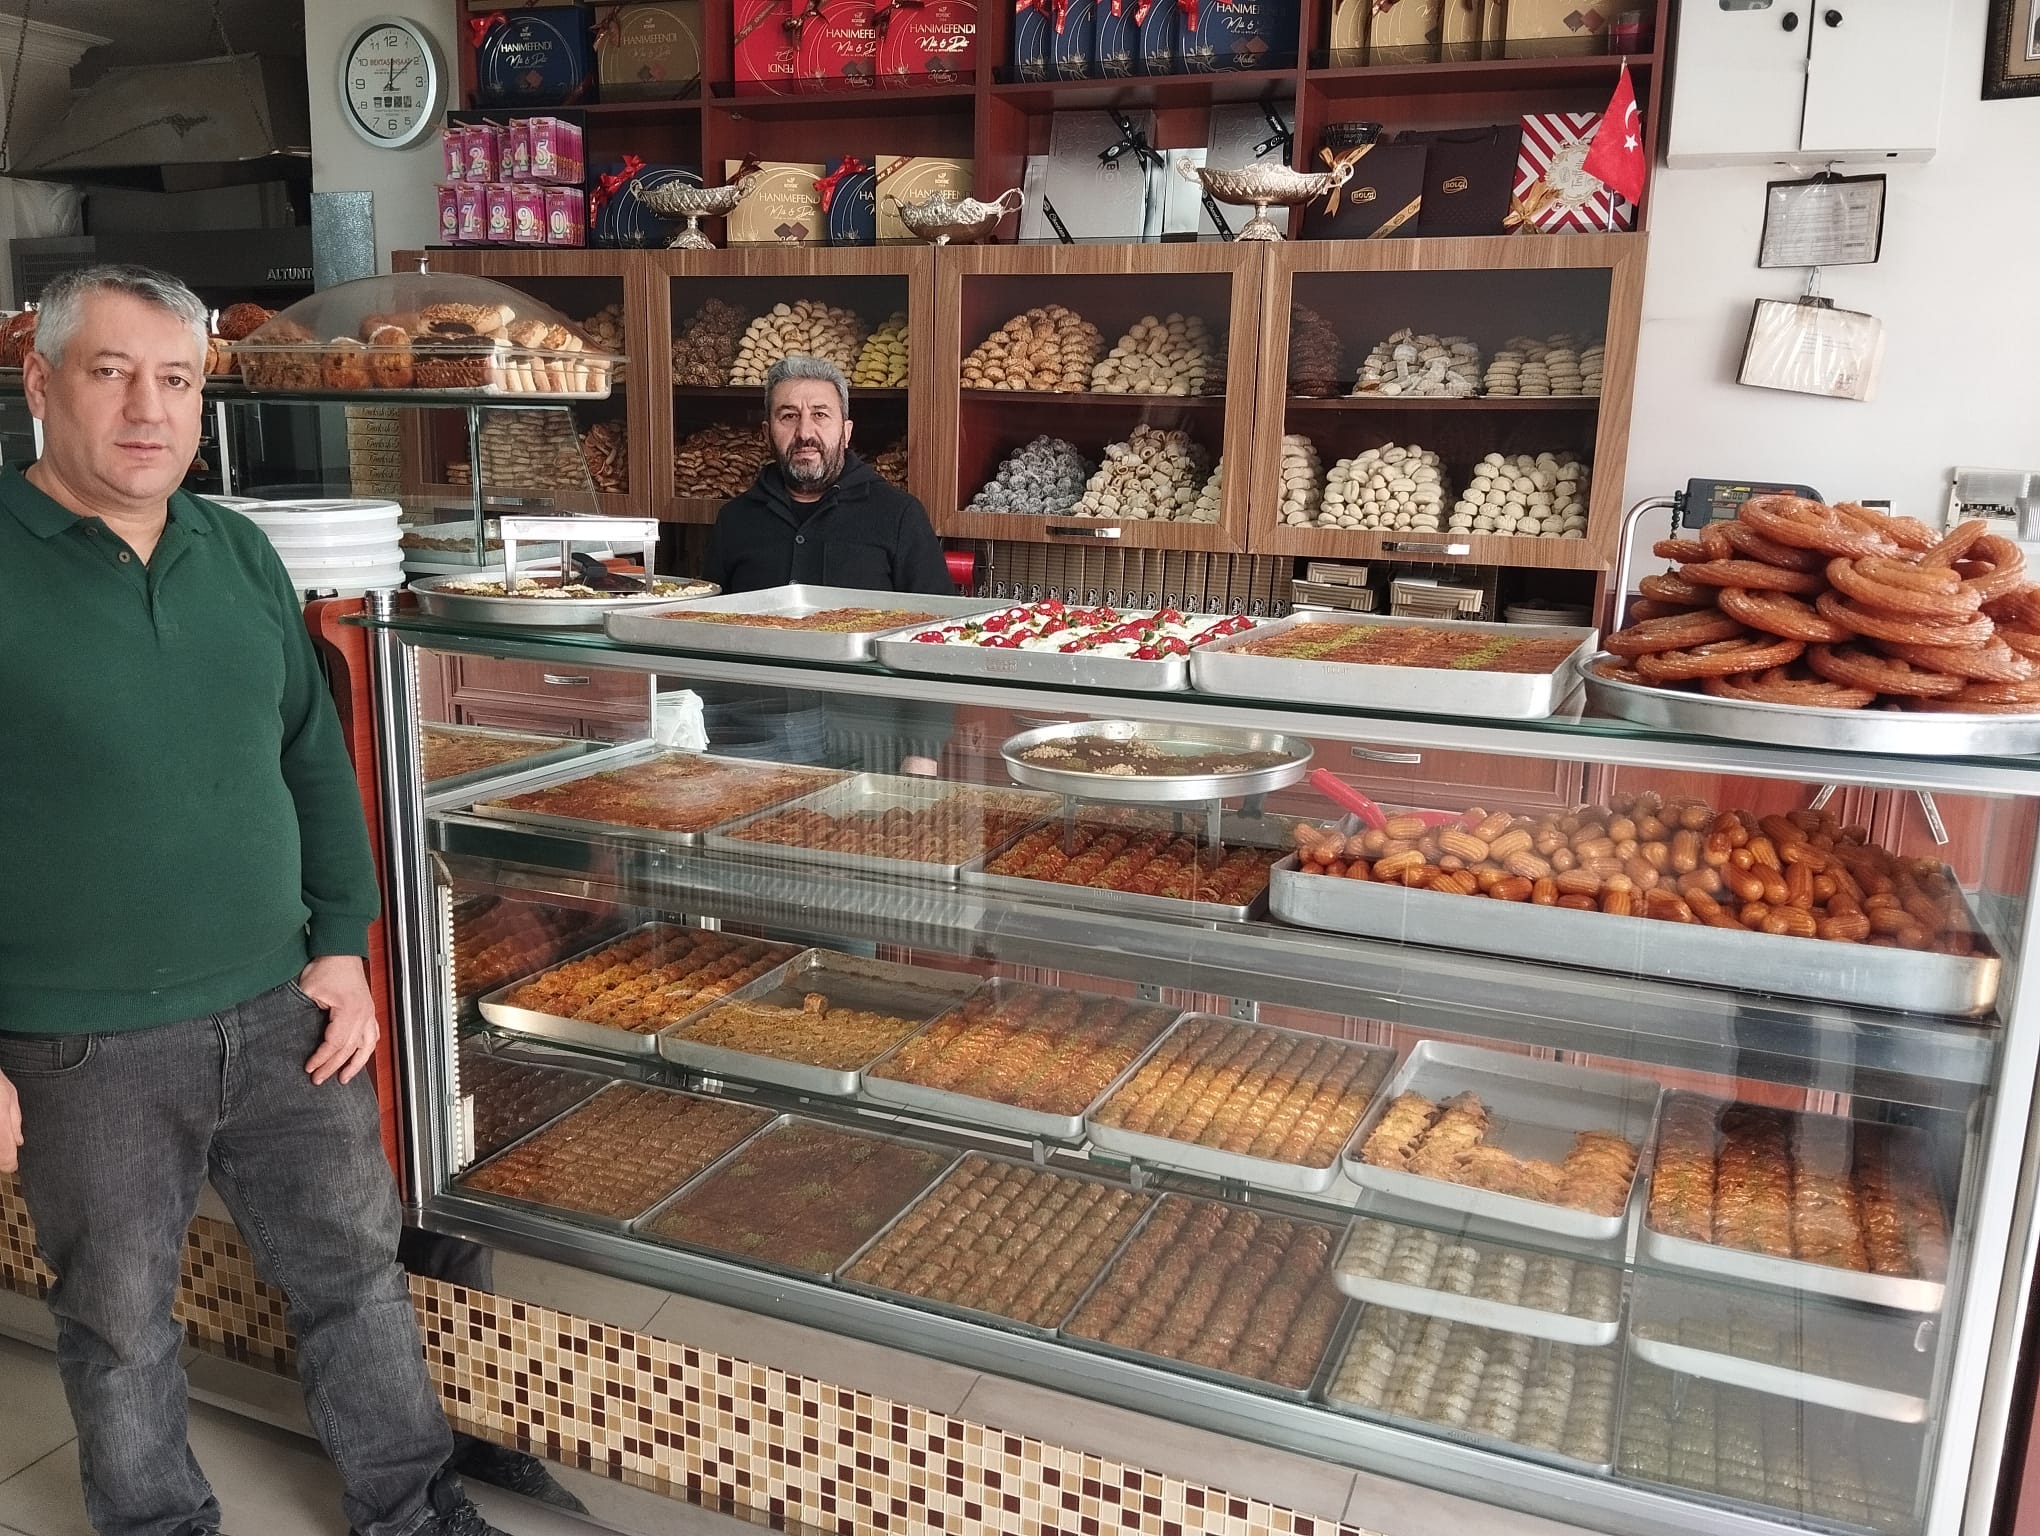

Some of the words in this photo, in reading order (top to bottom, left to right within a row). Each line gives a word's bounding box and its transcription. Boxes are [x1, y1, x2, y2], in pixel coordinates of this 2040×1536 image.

[909, 24, 976, 34] HANIMEFENDI
[370, 42, 379, 51] 11
[383, 36, 398, 47] 12
[501, 42, 553, 52] HANIMEFENDI
[358, 59, 368, 67] 10
[413, 57, 420, 66] 2
[355, 78, 366, 90] 9
[416, 76, 424, 88] 3
[360, 101, 368, 109] 8
[373, 117, 380, 126] 7
[388, 119, 398, 130] 6
[404, 117, 411, 125] 5
[469, 147, 486, 170] 2
[502, 148, 514, 169] 3
[515, 141, 529, 168] 4
[535, 140, 552, 166] 5
[449, 150, 462, 173] 1
[443, 206, 457, 230] 6
[461, 203, 477, 229] 7
[490, 205, 508, 229] 8
[517, 207, 535, 231] 9
[550, 209, 568, 235] 0
[266, 267, 313, 280] ALTUNT
